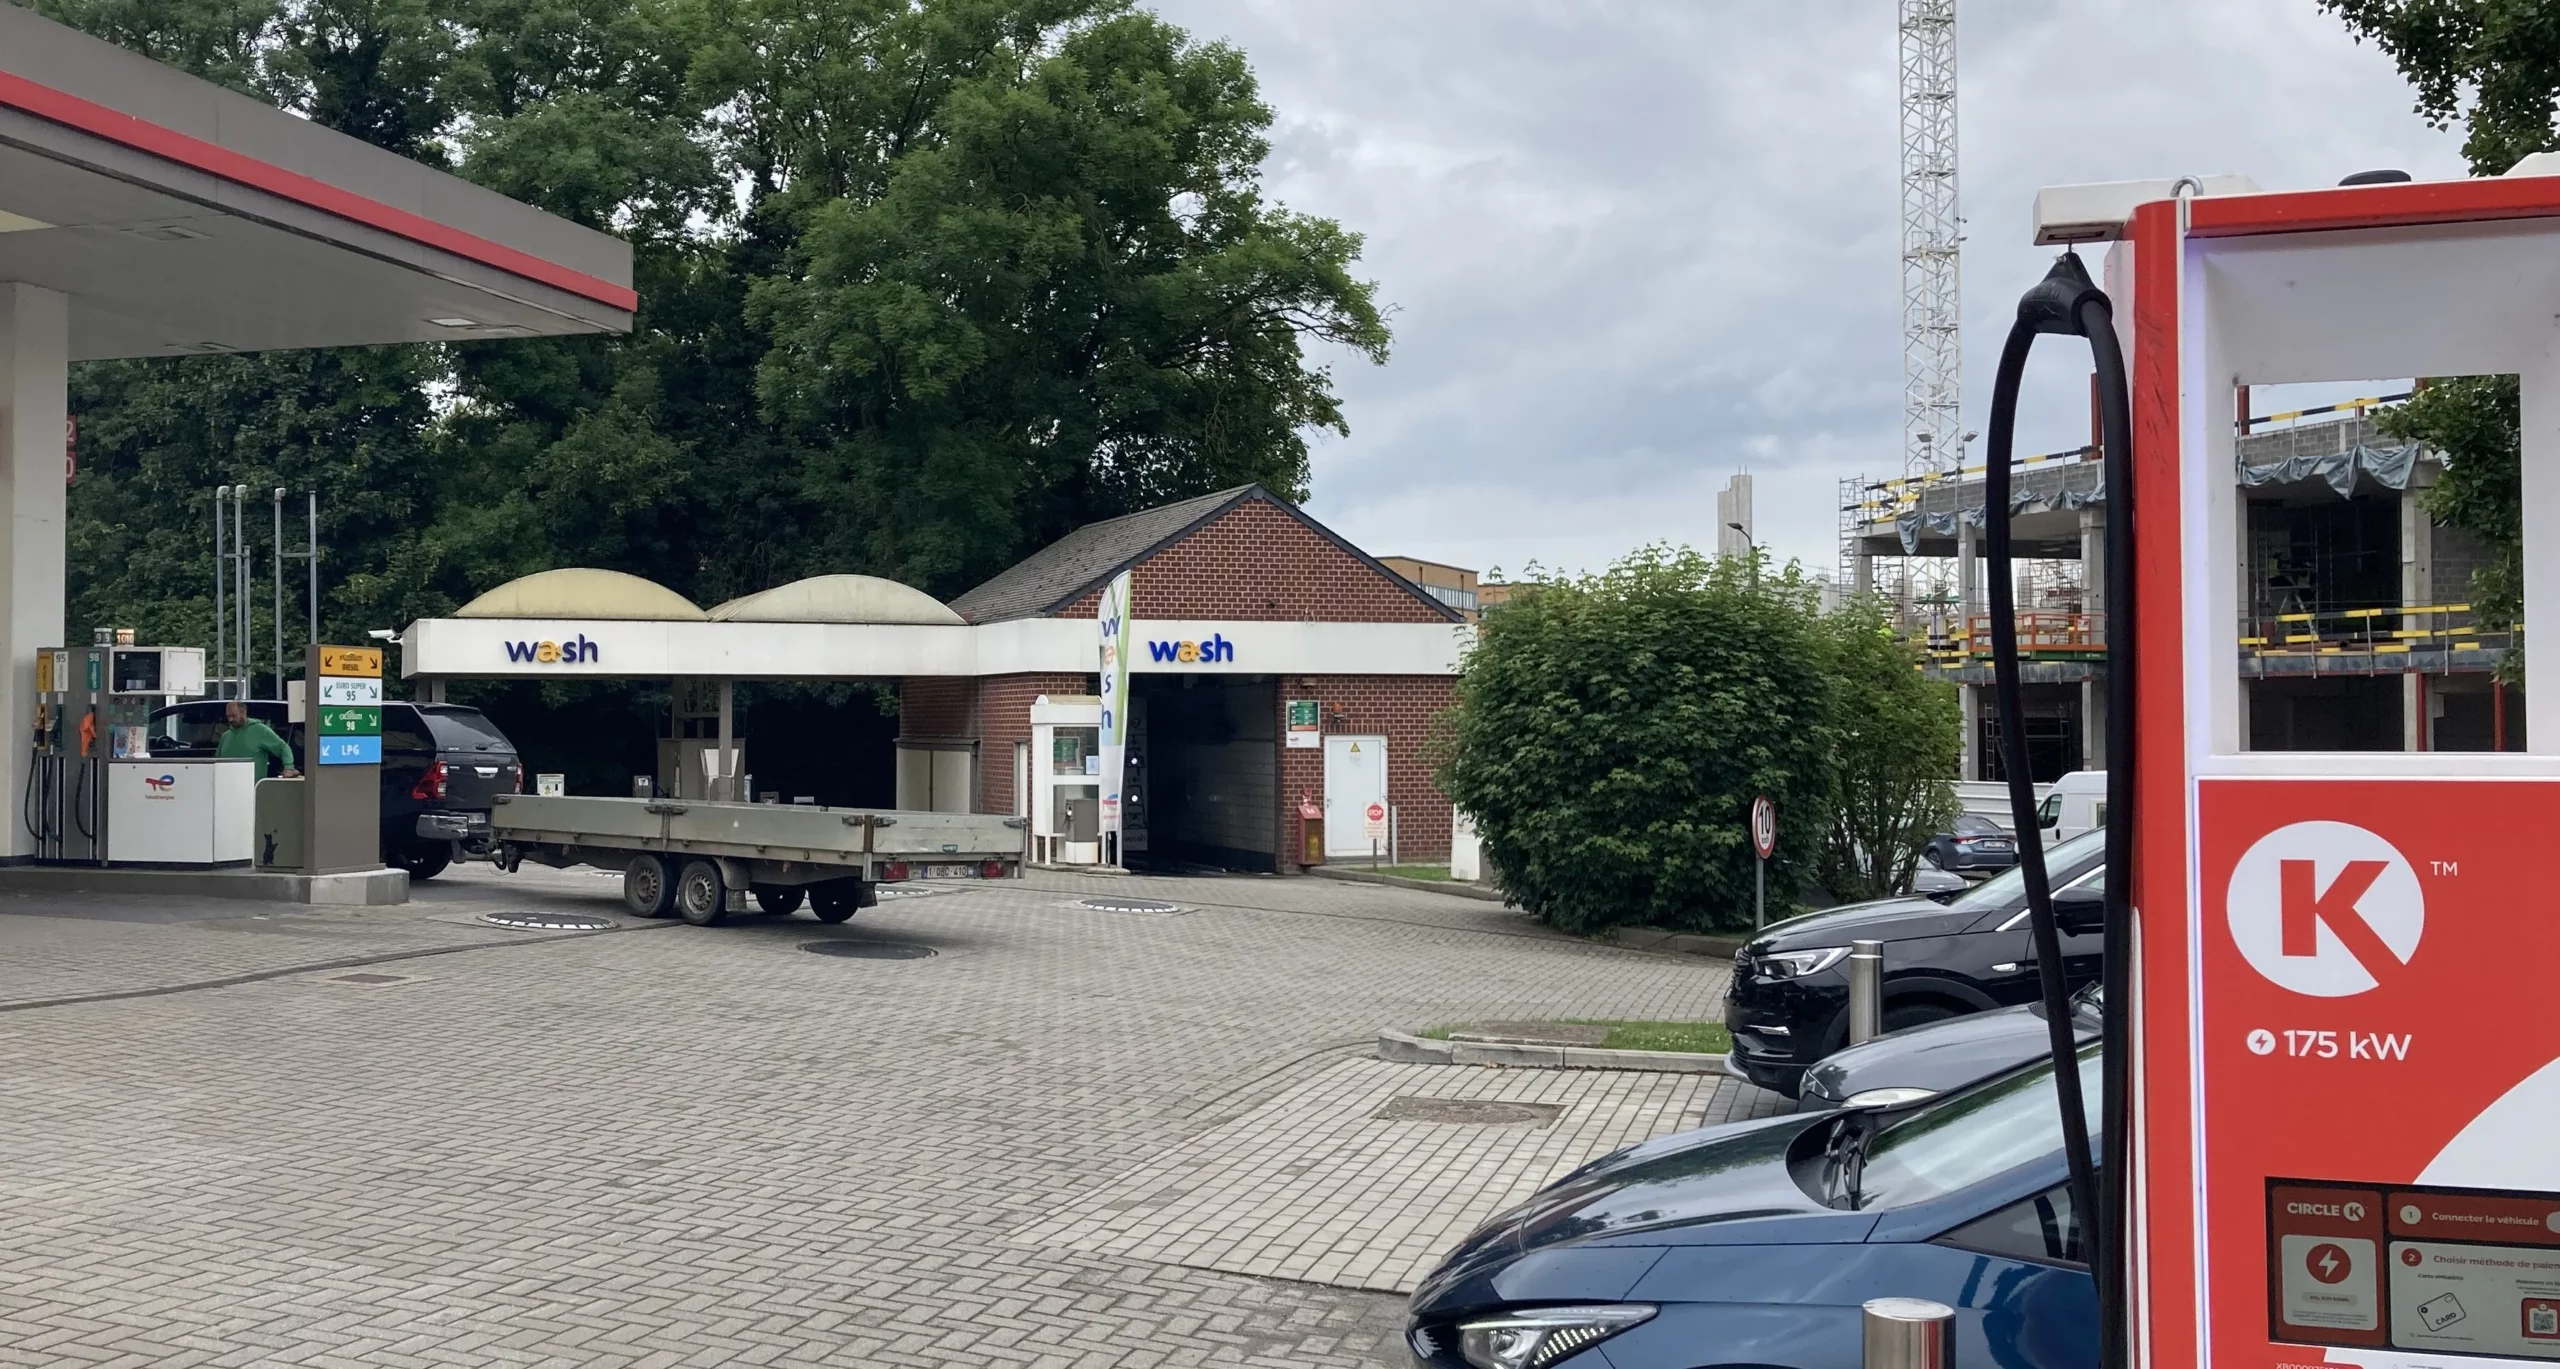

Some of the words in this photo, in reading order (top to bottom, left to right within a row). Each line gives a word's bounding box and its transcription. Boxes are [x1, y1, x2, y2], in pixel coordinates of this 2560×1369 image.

[504, 632, 599, 663] wash
[1148, 632, 1234, 663] wash
[55, 653, 67, 663] 95
[88, 652, 100, 662] 98
[336, 682, 349, 690] EURO
[350, 682, 367, 690] SUPER
[346, 691, 356, 701] 95
[345, 720, 356, 731] 98
[341, 744, 360, 756] LPG
[1367, 808, 1383, 816] STOP
[1759, 805, 1771, 835] 10
[2283, 1030, 2339, 1059] 175
[2349, 1031, 2413, 1061] kW
[2286, 1202, 2341, 1217] CIRCLE
[2431, 1212, 2484, 1223] Connecter
[2485, 1214, 2496, 1224] le
[2497, 1216, 2540, 1226] véhicule
[2408, 1253, 2416, 1262] 2
[2433, 1255, 2468, 1265] Choisir
[2469, 1257, 2516, 1268] méthode
[2517, 1260, 2531, 1269] de
[2436, 1312, 2457, 1326] CARD
